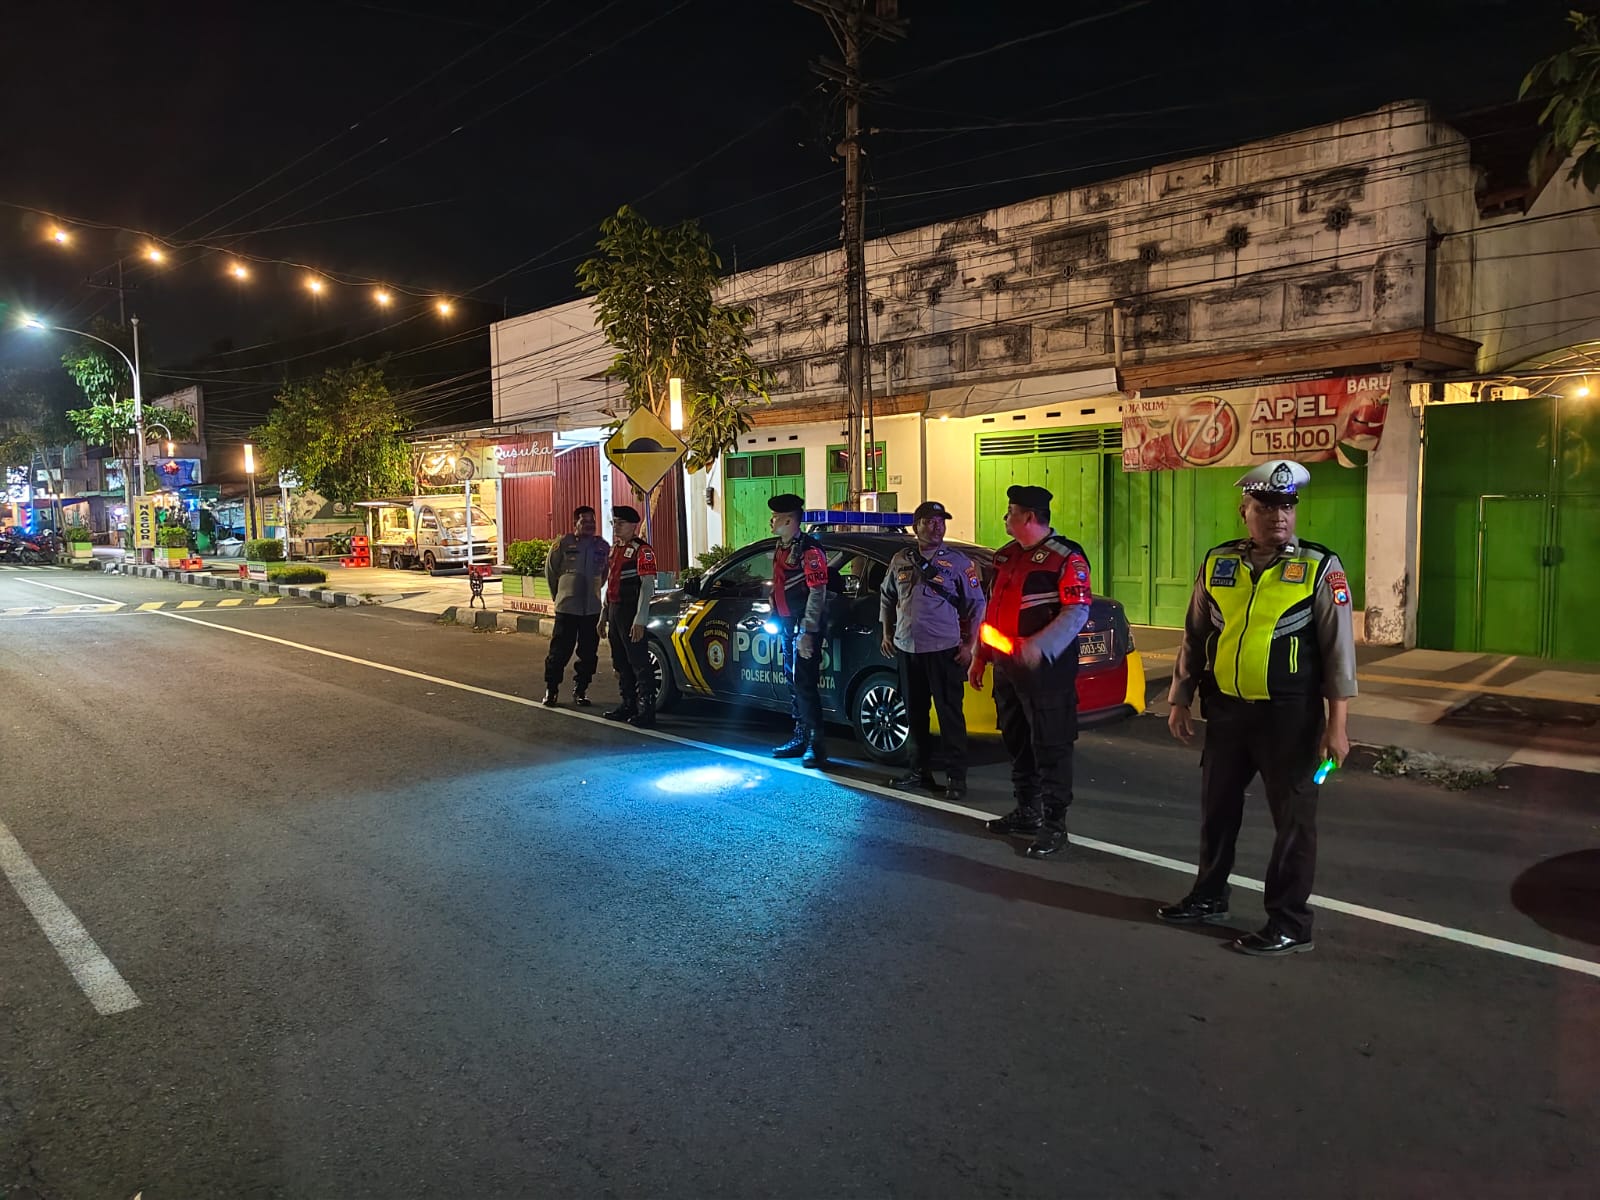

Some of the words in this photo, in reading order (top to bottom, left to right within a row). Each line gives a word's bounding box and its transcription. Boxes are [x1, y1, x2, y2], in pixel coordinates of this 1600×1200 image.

[1347, 376, 1391, 394] BARU
[1252, 395, 1337, 422] APEL
[494, 441, 553, 460] Qusuka
[140, 505, 150, 540] NASGOR
[807, 571, 825, 583] ATRO
[741, 668, 770, 683] POLSEK
